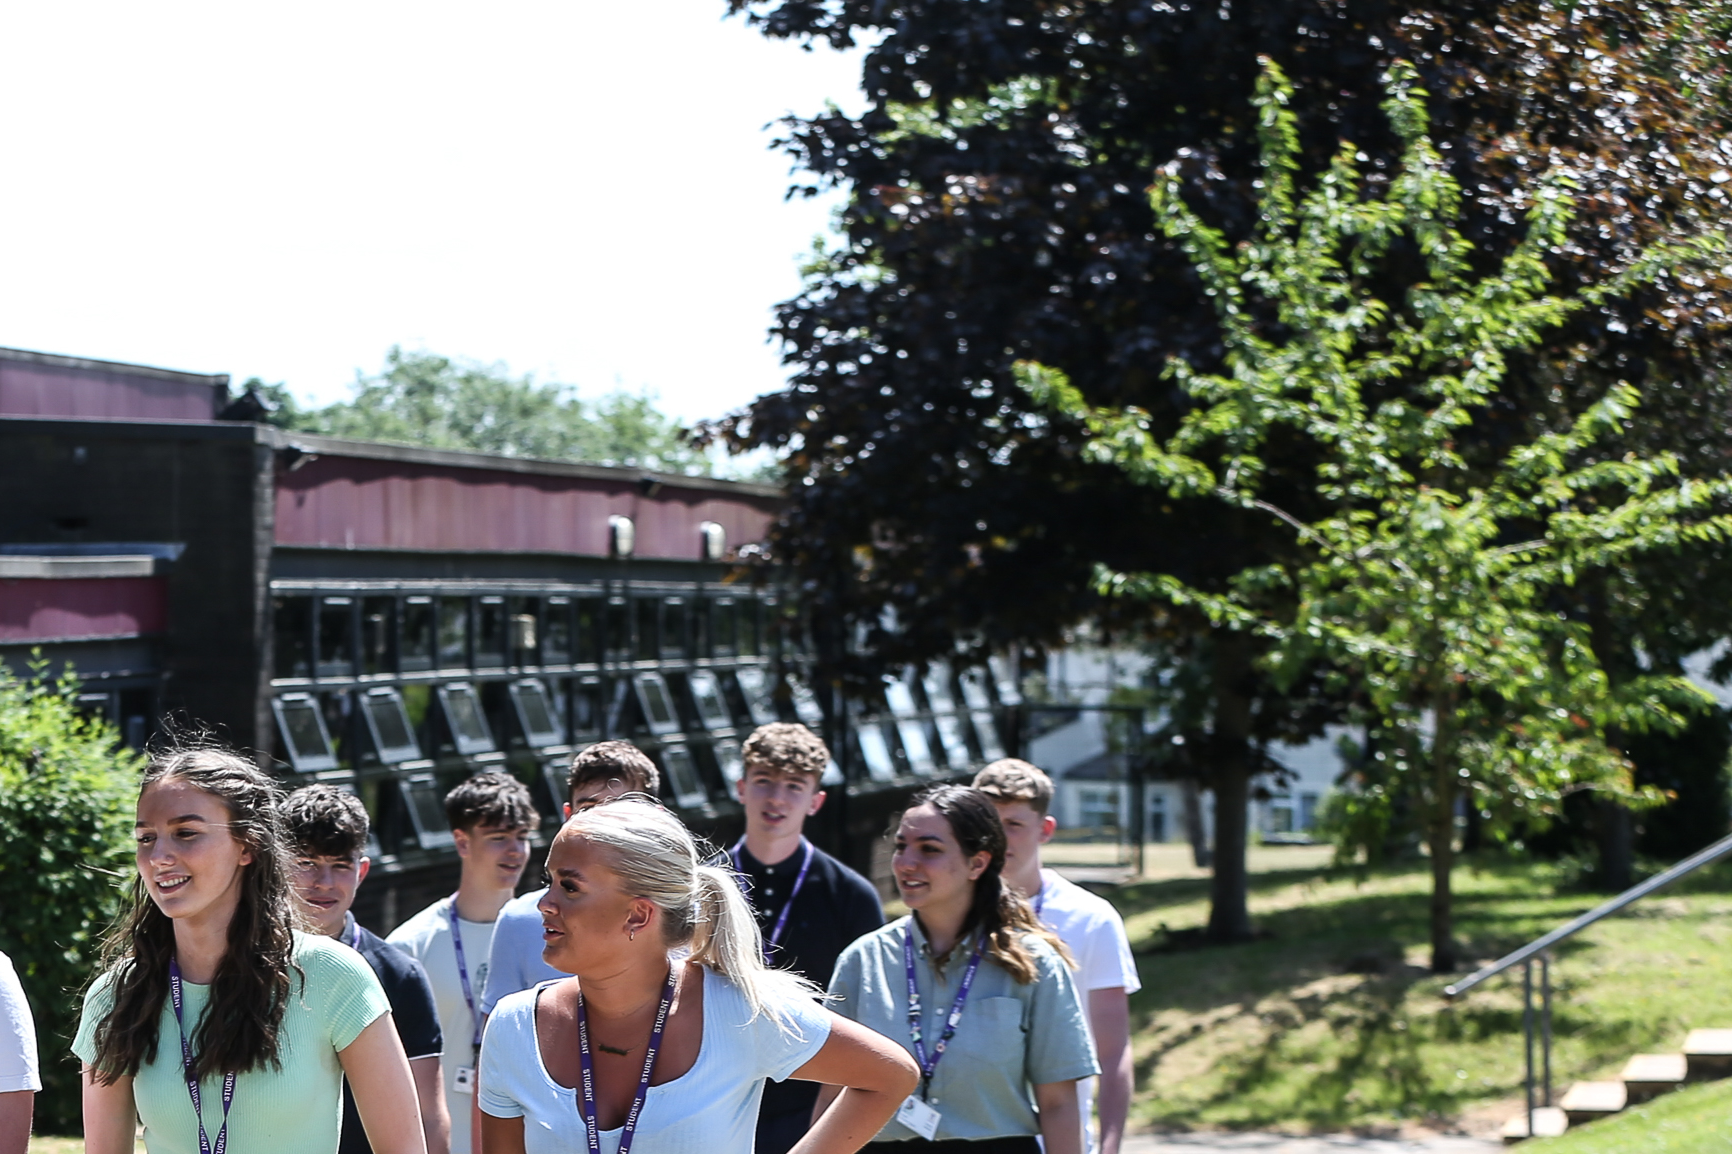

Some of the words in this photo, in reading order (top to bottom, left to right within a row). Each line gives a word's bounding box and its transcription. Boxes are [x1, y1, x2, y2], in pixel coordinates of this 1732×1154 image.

[654, 998, 669, 1034] STUDENT
[580, 1020, 589, 1054] STUDENT
[641, 1048, 656, 1083] STUDENT
[224, 1070, 234, 1102] STUDEN
[582, 1068, 594, 1102] STUDENT
[626, 1098, 642, 1132] STUDENT
[586, 1116, 598, 1150] STUDENT
